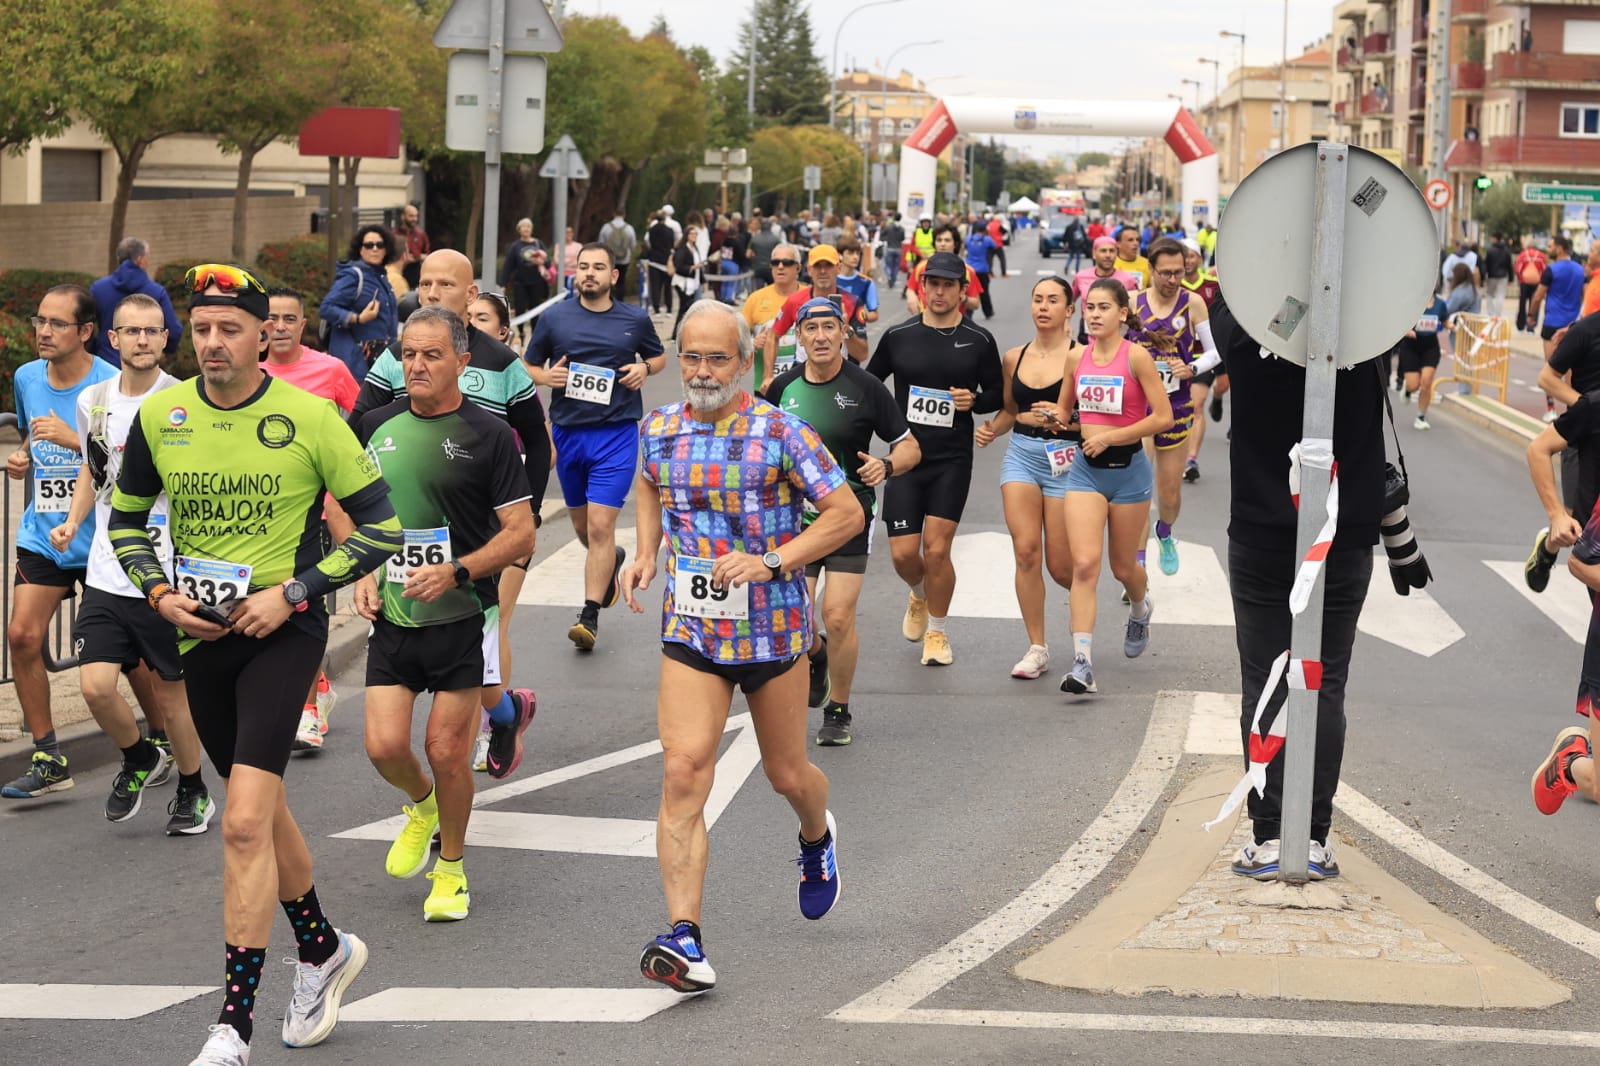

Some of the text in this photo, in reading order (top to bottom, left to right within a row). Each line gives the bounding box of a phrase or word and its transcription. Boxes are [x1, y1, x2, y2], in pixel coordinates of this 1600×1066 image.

[571, 374, 609, 392] 566
[1081, 386, 1116, 403] 491
[912, 397, 951, 416] 406
[167, 472, 281, 496] CORRECAMINOS
[178, 523, 267, 537] SALAMANCA
[182, 576, 238, 607] 332
[690, 575, 729, 601] 89
